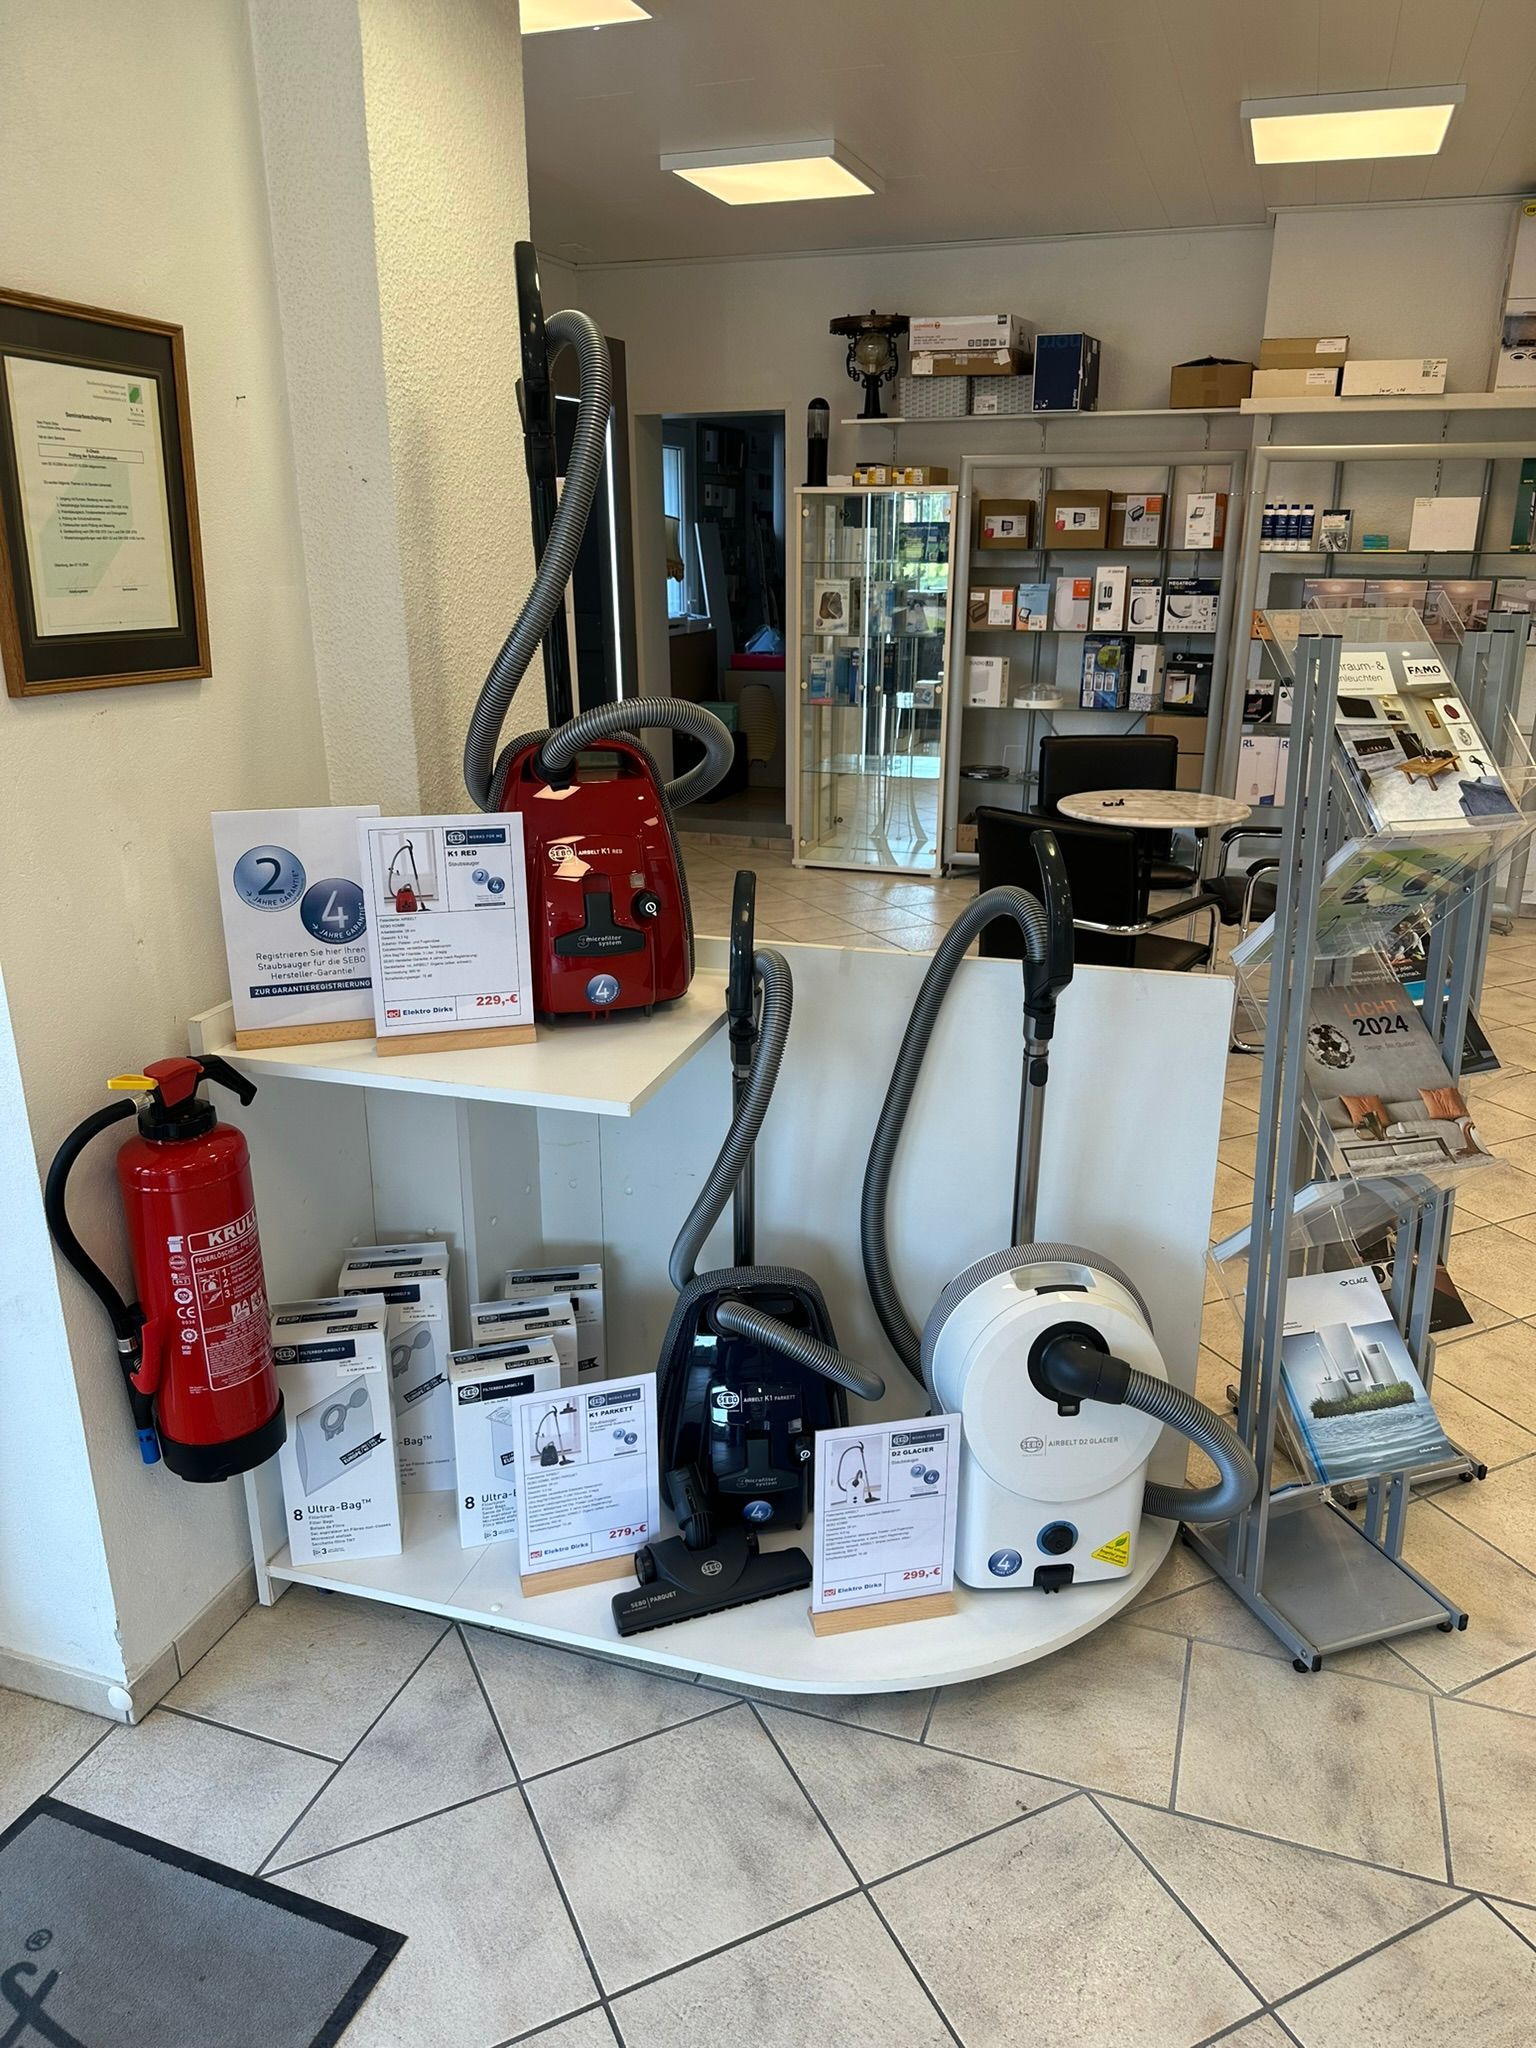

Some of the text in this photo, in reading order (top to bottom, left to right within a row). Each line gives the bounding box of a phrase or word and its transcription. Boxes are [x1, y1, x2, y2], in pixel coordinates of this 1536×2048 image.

[1103, 586, 1113, 599] 10
[550, 849, 573, 857] SEBO
[256, 857, 285, 896] 2
[254, 896, 278, 907] JAHRE
[321, 890, 349, 929] 4
[320, 929, 344, 939] JAHRE
[256, 946, 366, 962] Registrieren Sie hier Ihren
[258, 961, 311, 971] Staubsauger
[328, 957, 341, 966] die
[342, 955, 366, 965] SEBO
[271, 967, 356, 980] Hersteller-Garantie!
[254, 980, 371, 996] ZUR GARANTIEREGISTRIERUNG
[596, 979, 610, 999] 4
[475, 994, 518, 1006] 229,-€
[402, 1008, 431, 1016] Elektro
[1344, 1000, 1398, 1017] LICHT
[1352, 1015, 1409, 1036] 2024
[195, 1244, 239, 1265] FEUERLÖSCHER
[223, 1278, 232, 1288] 2.
[1348, 1276, 1369, 1286] CLAGE
[224, 1289, 234, 1299] 3.
[718, 1396, 739, 1404] SEBO
[600, 1406, 633, 1416] PARKETT
[1021, 1441, 1043, 1449] SEBO
[1089, 1436, 1119, 1444] GLACIER
[903, 1446, 934, 1456] GLACIER
[465, 1496, 475, 1510] 8
[293, 1509, 304, 1521] 8
[751, 1504, 764, 1519] 4
[609, 1524, 647, 1539] 279,-€
[544, 1546, 569, 1556] Elektro
[570, 1542, 589, 1550] Dirks
[702, 1563, 721, 1573] SEBO
[997, 1554, 1010, 1571] 4
[903, 1567, 941, 1580] 299,-€
[838, 1584, 862, 1594] Elektro
[630, 1590, 677, 1609] SEBO PARQUET
